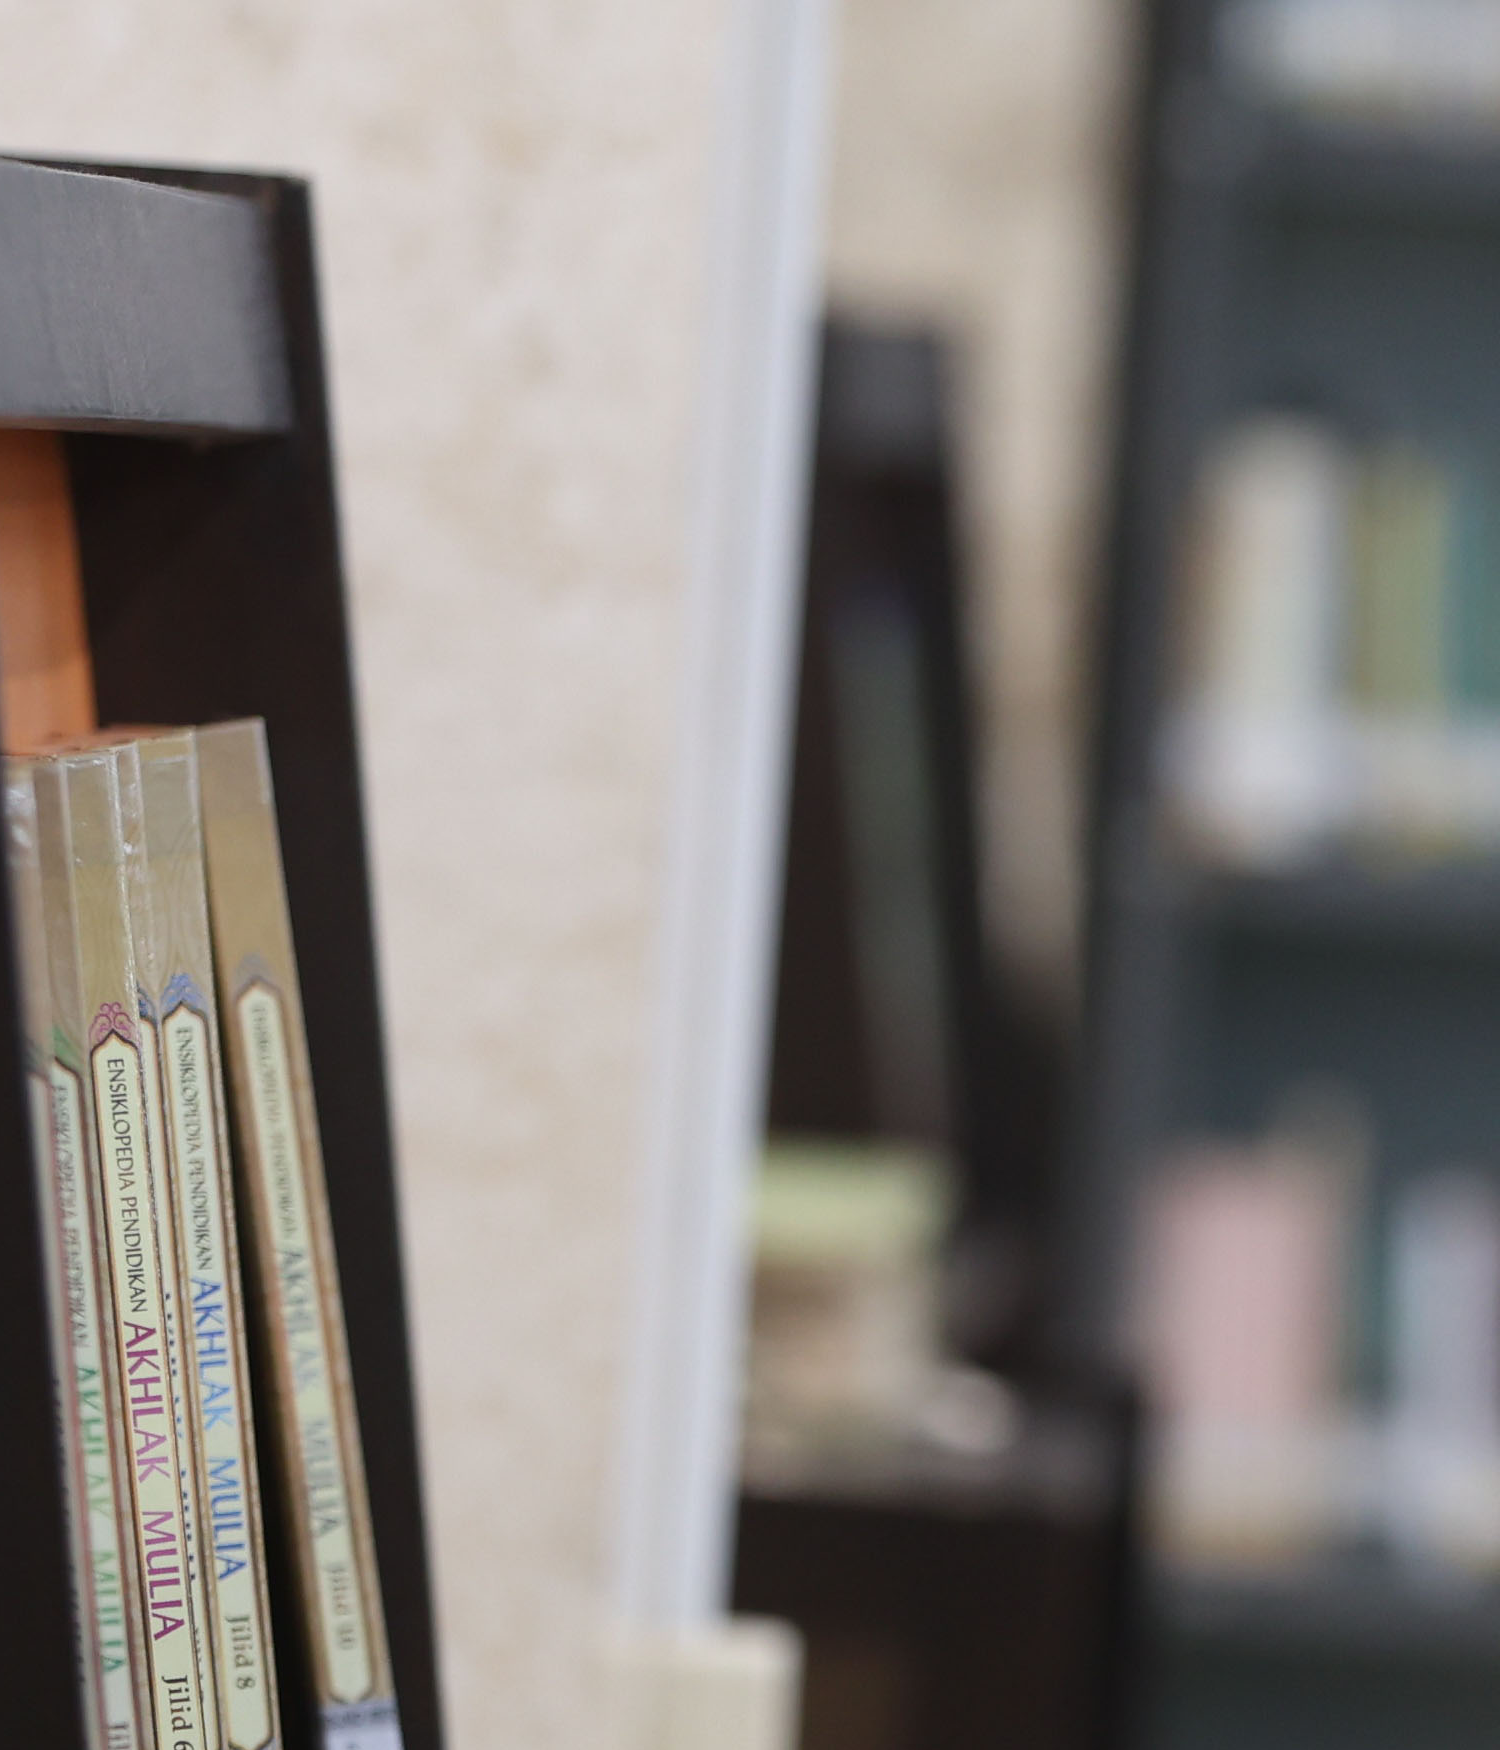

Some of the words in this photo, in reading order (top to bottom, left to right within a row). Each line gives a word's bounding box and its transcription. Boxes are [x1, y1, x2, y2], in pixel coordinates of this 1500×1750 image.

[107, 1057, 136, 1192] ENSIKLOPEDIA
[175, 1026, 203, 1155] ENSIKLOPEDIA
[120, 1196, 148, 1314] PENDIDIKAN
[188, 1158, 215, 1272] PENDIDIKAN
[123, 1320, 171, 1484] AKHLAK
[190, 1277, 236, 1431] AKHLAK
[141, 1510, 185, 1641] MULIA
[206, 1456, 248, 1581] MULIA
[161, 1674, 194, 1733] Jilid
[225, 1614, 254, 1669] Jilid
[236, 1676, 256, 1691] 8
